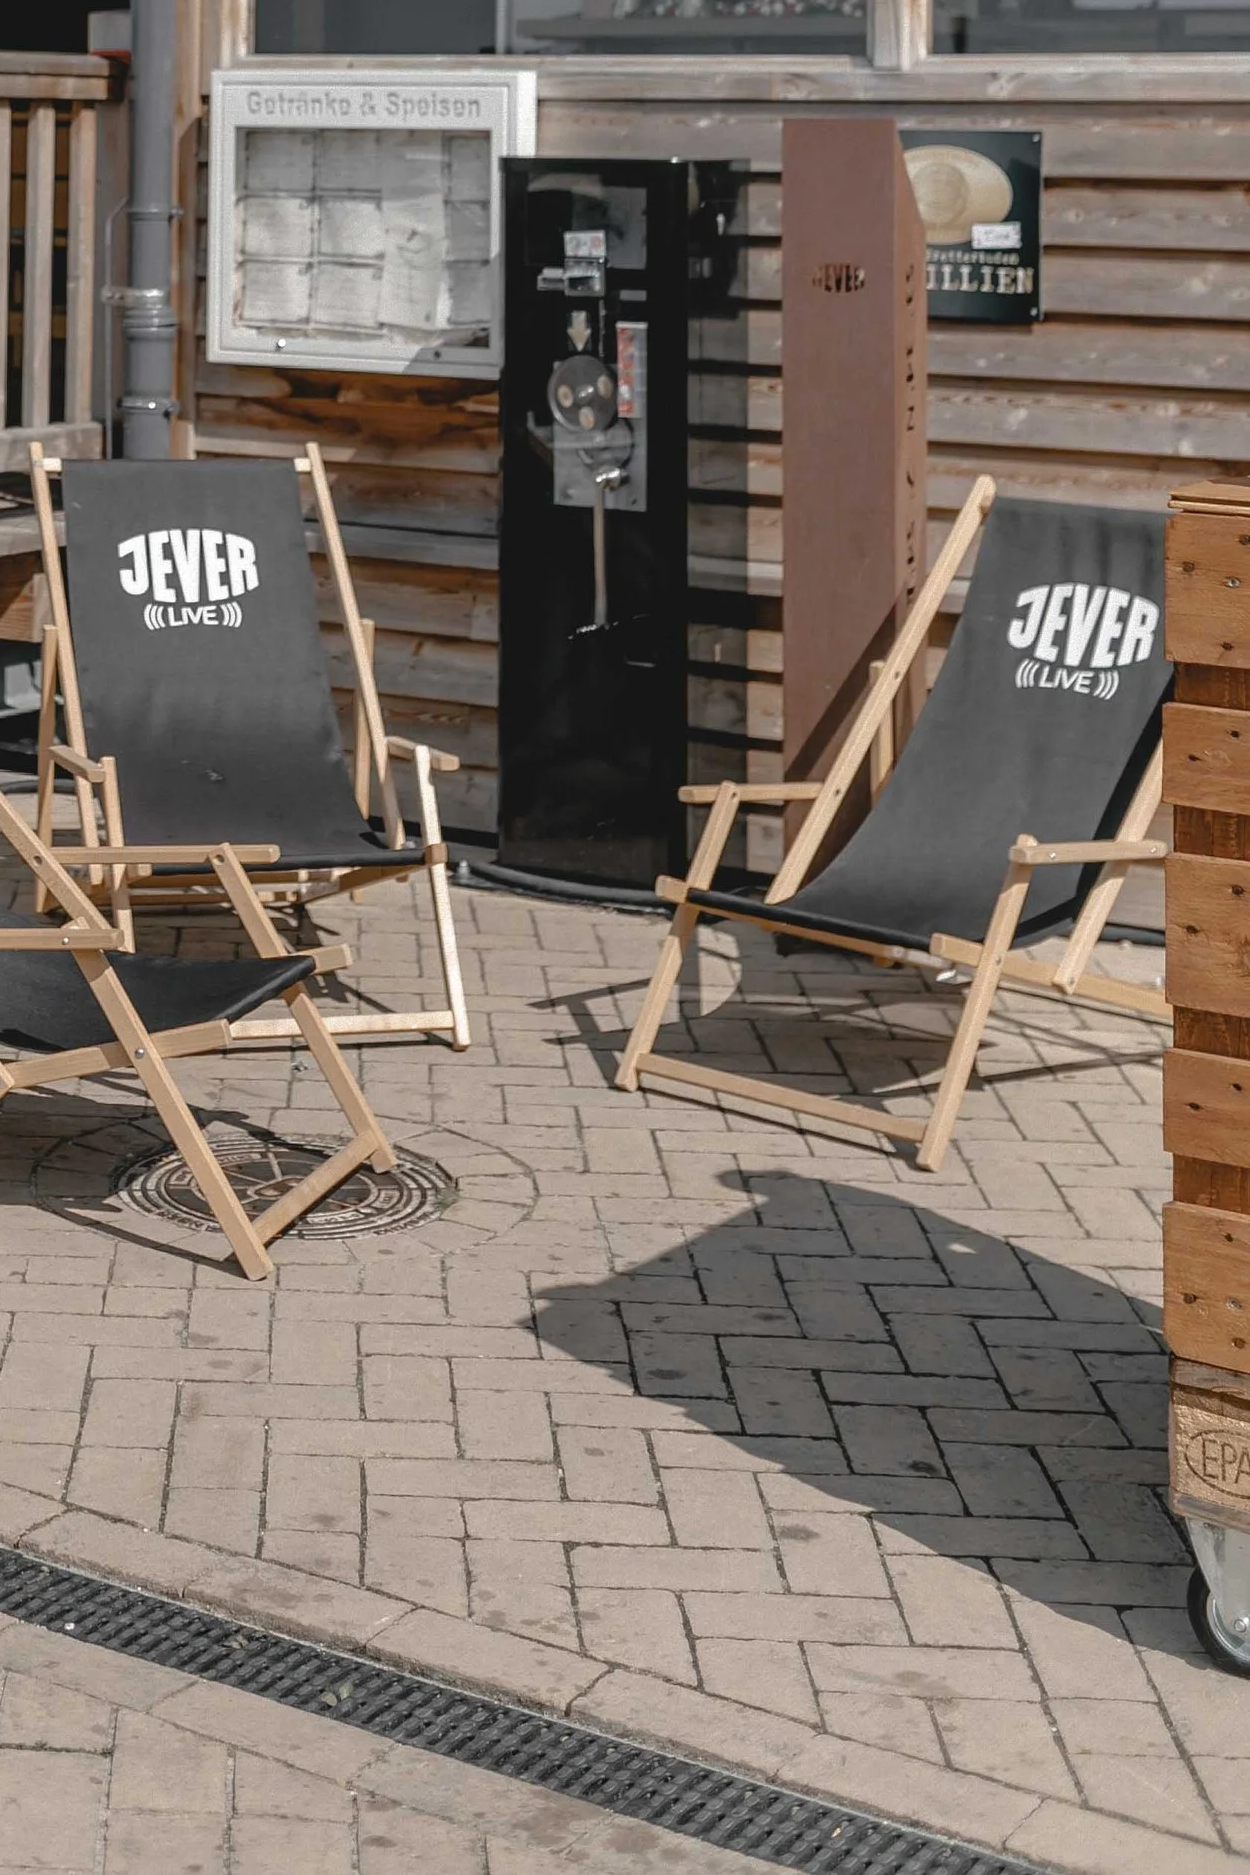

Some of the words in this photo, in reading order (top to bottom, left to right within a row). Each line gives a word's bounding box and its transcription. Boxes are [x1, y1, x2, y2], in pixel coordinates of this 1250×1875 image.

[246, 90, 352, 116] Getränke
[360, 91, 377, 116] &
[384, 91, 482, 121] Speisen
[925, 264, 1035, 294] ILLIEN
[118, 528, 260, 603] JEVER
[1007, 582, 1160, 668] JEVER
[1201, 1437, 1250, 1485] EPA
